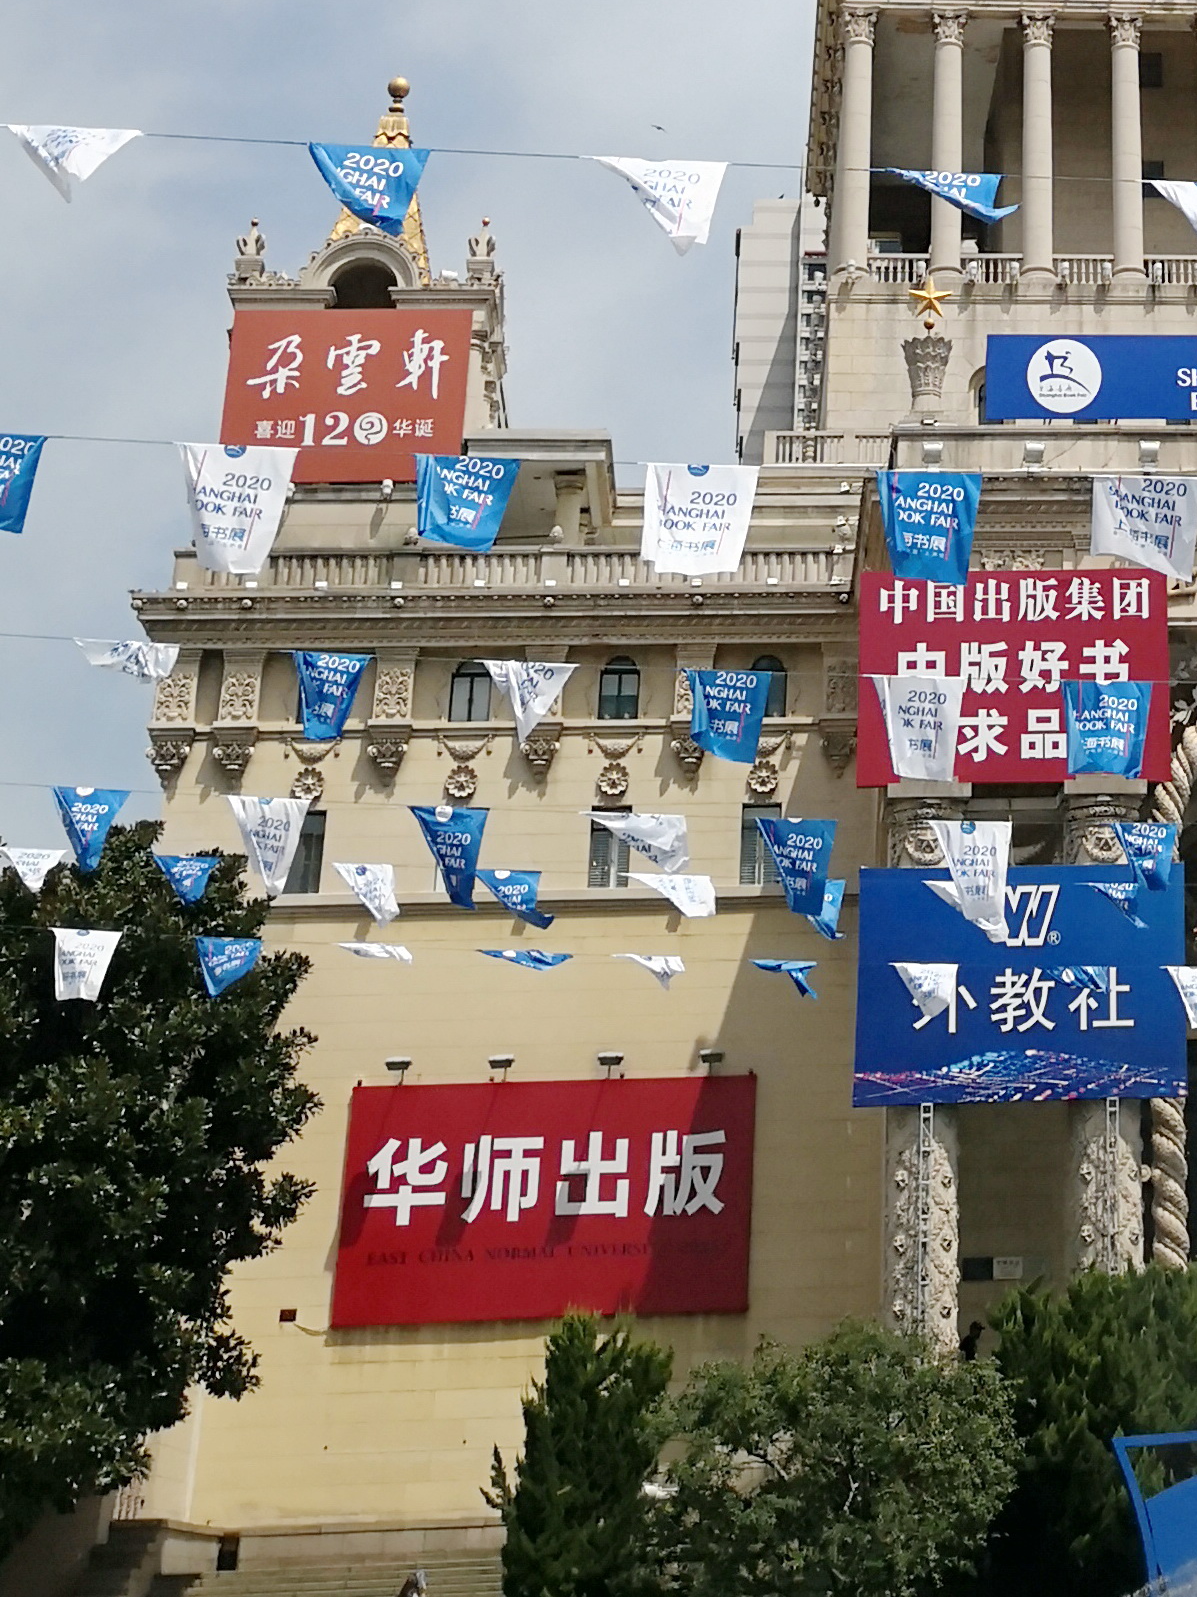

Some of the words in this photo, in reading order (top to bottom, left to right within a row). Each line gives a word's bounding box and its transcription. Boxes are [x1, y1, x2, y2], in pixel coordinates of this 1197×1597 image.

[343, 152, 405, 178] 2020
[337, 167, 387, 191] GHAI
[643, 168, 702, 185] 2020
[924, 171, 982, 187] 2020
[354, 188, 391, 209] FAIR
[459, 455, 505, 480] 2020
[222, 472, 272, 492] 2020
[1141, 478, 1188, 497] 2020
[462, 489, 495, 507] FAIR
[690, 491, 738, 507] 2020
[917, 481, 965, 502] 2020
[232, 503, 263, 520] FAIR
[703, 520, 732, 532] FAIR
[930, 513, 959, 530] FAIR
[1154, 513, 1183, 528] FAIR
[879, 576, 1151, 625] 中国出版集团
[316, 654, 360, 673] 2020
[715, 671, 757, 688] 2020
[908, 690, 947, 704] 2020
[1099, 695, 1138, 711] 2020
[725, 700, 751, 714] FAIR
[919, 718, 943, 731] FAIR
[1109, 721, 1135, 734] FAIR
[957, 707, 1068, 763] 求品
[72, 803, 109, 815] 2020
[258, 816, 291, 832] 2020
[1132, 822, 1167, 839] 2020
[436, 832, 471, 845] 2020
[786, 833, 823, 850] 2020
[963, 844, 998, 858] 2020
[444, 857, 466, 869] FAIR
[795, 860, 817, 873] FAIR
[496, 884, 529, 896] 2020
[74, 942, 105, 952] 2020
[362, 1129, 727, 1227] 华师出版
